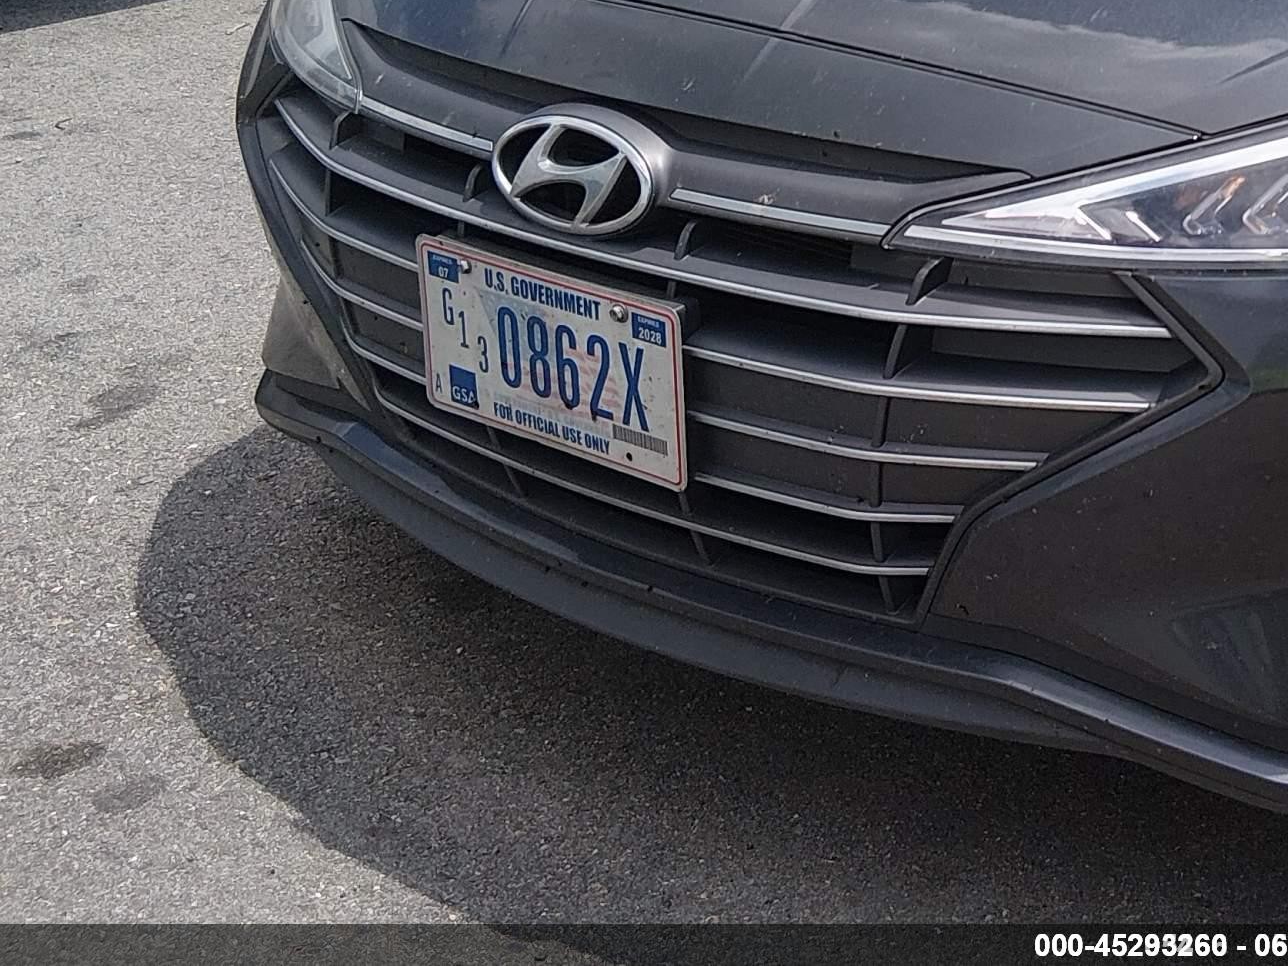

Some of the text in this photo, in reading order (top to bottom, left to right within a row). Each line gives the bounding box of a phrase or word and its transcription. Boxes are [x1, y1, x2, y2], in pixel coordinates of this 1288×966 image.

[484, 267, 601, 321] U.S. GOVERNMENT
[638, 327, 662, 345] 2028
[452, 385, 477, 404] GSA
[497, 306, 650, 433] 0862X
[494, 402, 611, 455] FOR OFFICIAL USE ONLY
